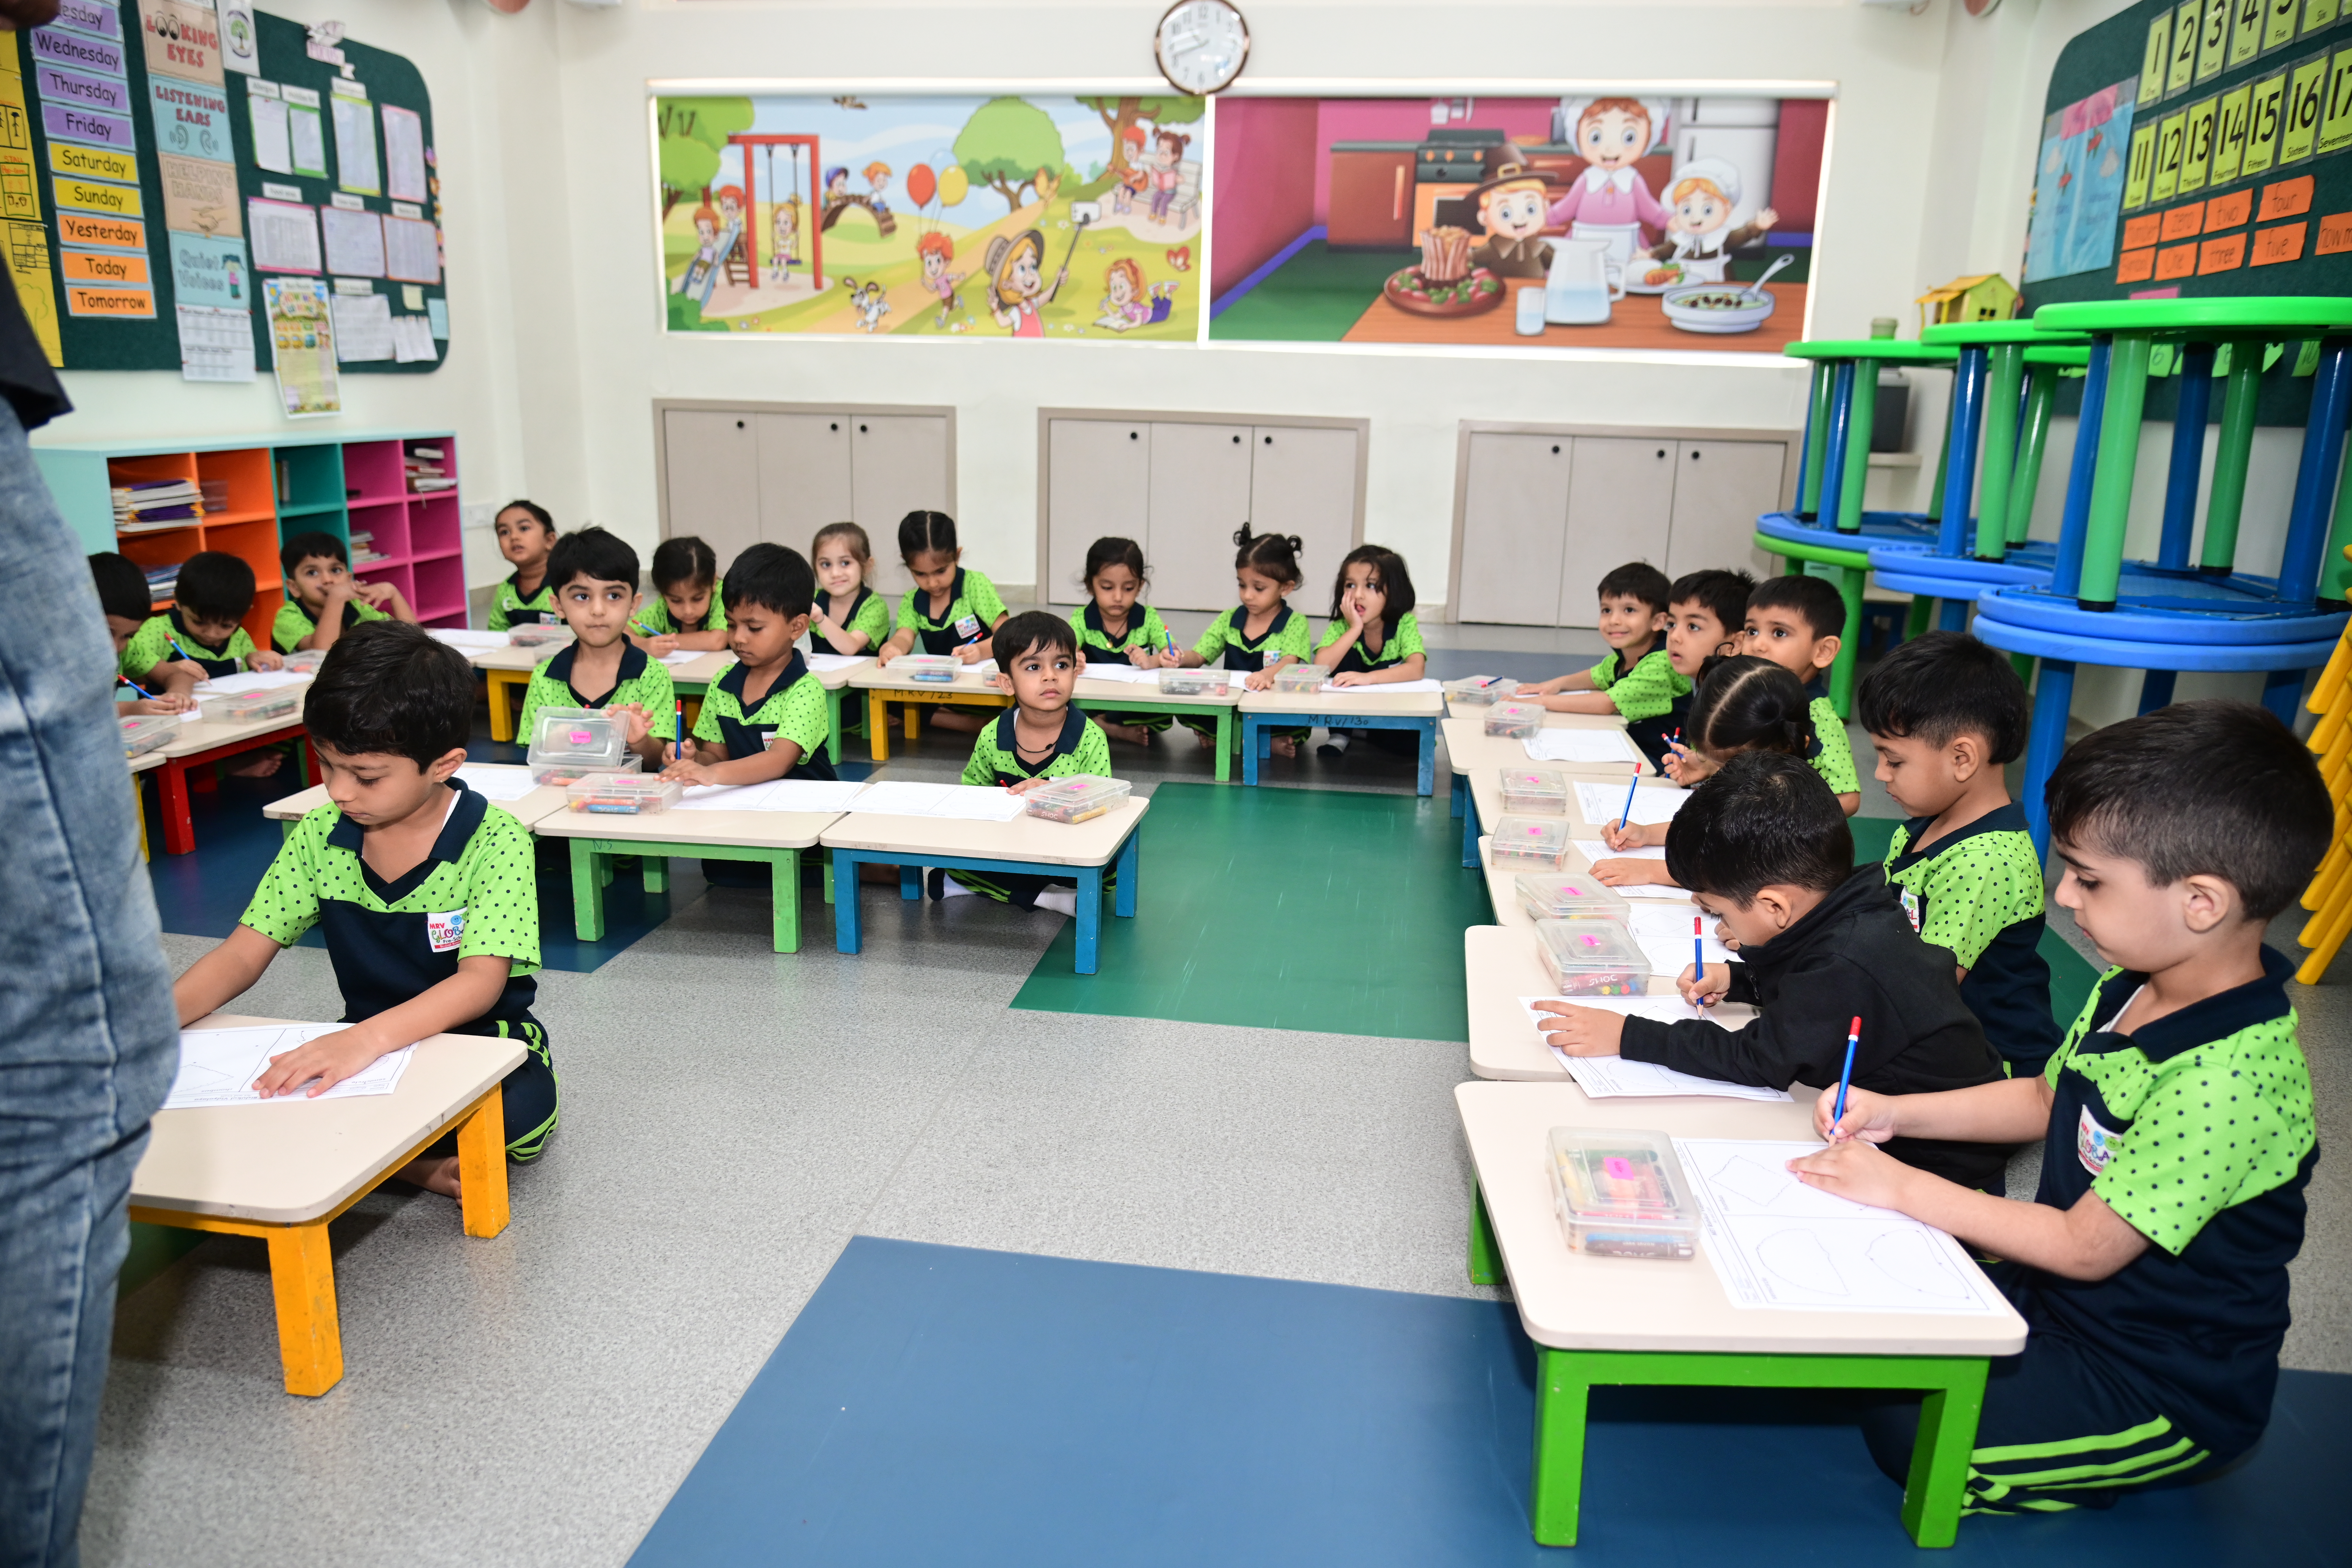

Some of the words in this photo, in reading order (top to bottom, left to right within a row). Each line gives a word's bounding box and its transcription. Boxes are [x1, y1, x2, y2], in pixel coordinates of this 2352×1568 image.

[60, 5, 103, 30] esday
[2177, 16, 2194, 63] 2
[2274, 29, 2287, 41] Five
[35, 32, 119, 71] Wednesday
[167, 43, 204, 68] EYES
[2153, 32, 2162, 74] 1
[50, 72, 117, 106] Thursday
[155, 85, 226, 114] LISTENING
[175, 107, 211, 127] EARS
[2289, 74, 2321, 133] 16
[66, 113, 112, 140] Friday
[2219, 103, 2243, 156] 14
[2251, 90, 2281, 146] 15
[2159, 127, 2181, 175] 12
[2188, 113, 2213, 165] 13
[2286, 144, 2309, 158] Sixteen
[63, 150, 126, 175] Saturday
[167, 160, 232, 189] HELPING
[2133, 141, 2149, 183] 11
[74, 187, 123, 210] Sunday
[172, 180, 223, 204] HANDS
[2272, 183, 2297, 213] four
[2216, 199, 2238, 226] two
[66, 219, 138, 246] Yesterday
[2266, 229, 2289, 258] five
[85, 257, 126, 280] Today
[179, 248, 220, 271] Quiet
[78, 291, 145, 309] Tomorrow
[1589, 974, 1618, 986] DOMS
[1718, 1195, 1730, 1211] rhombus
[1702, 1212, 1713, 1227] Rishikul
